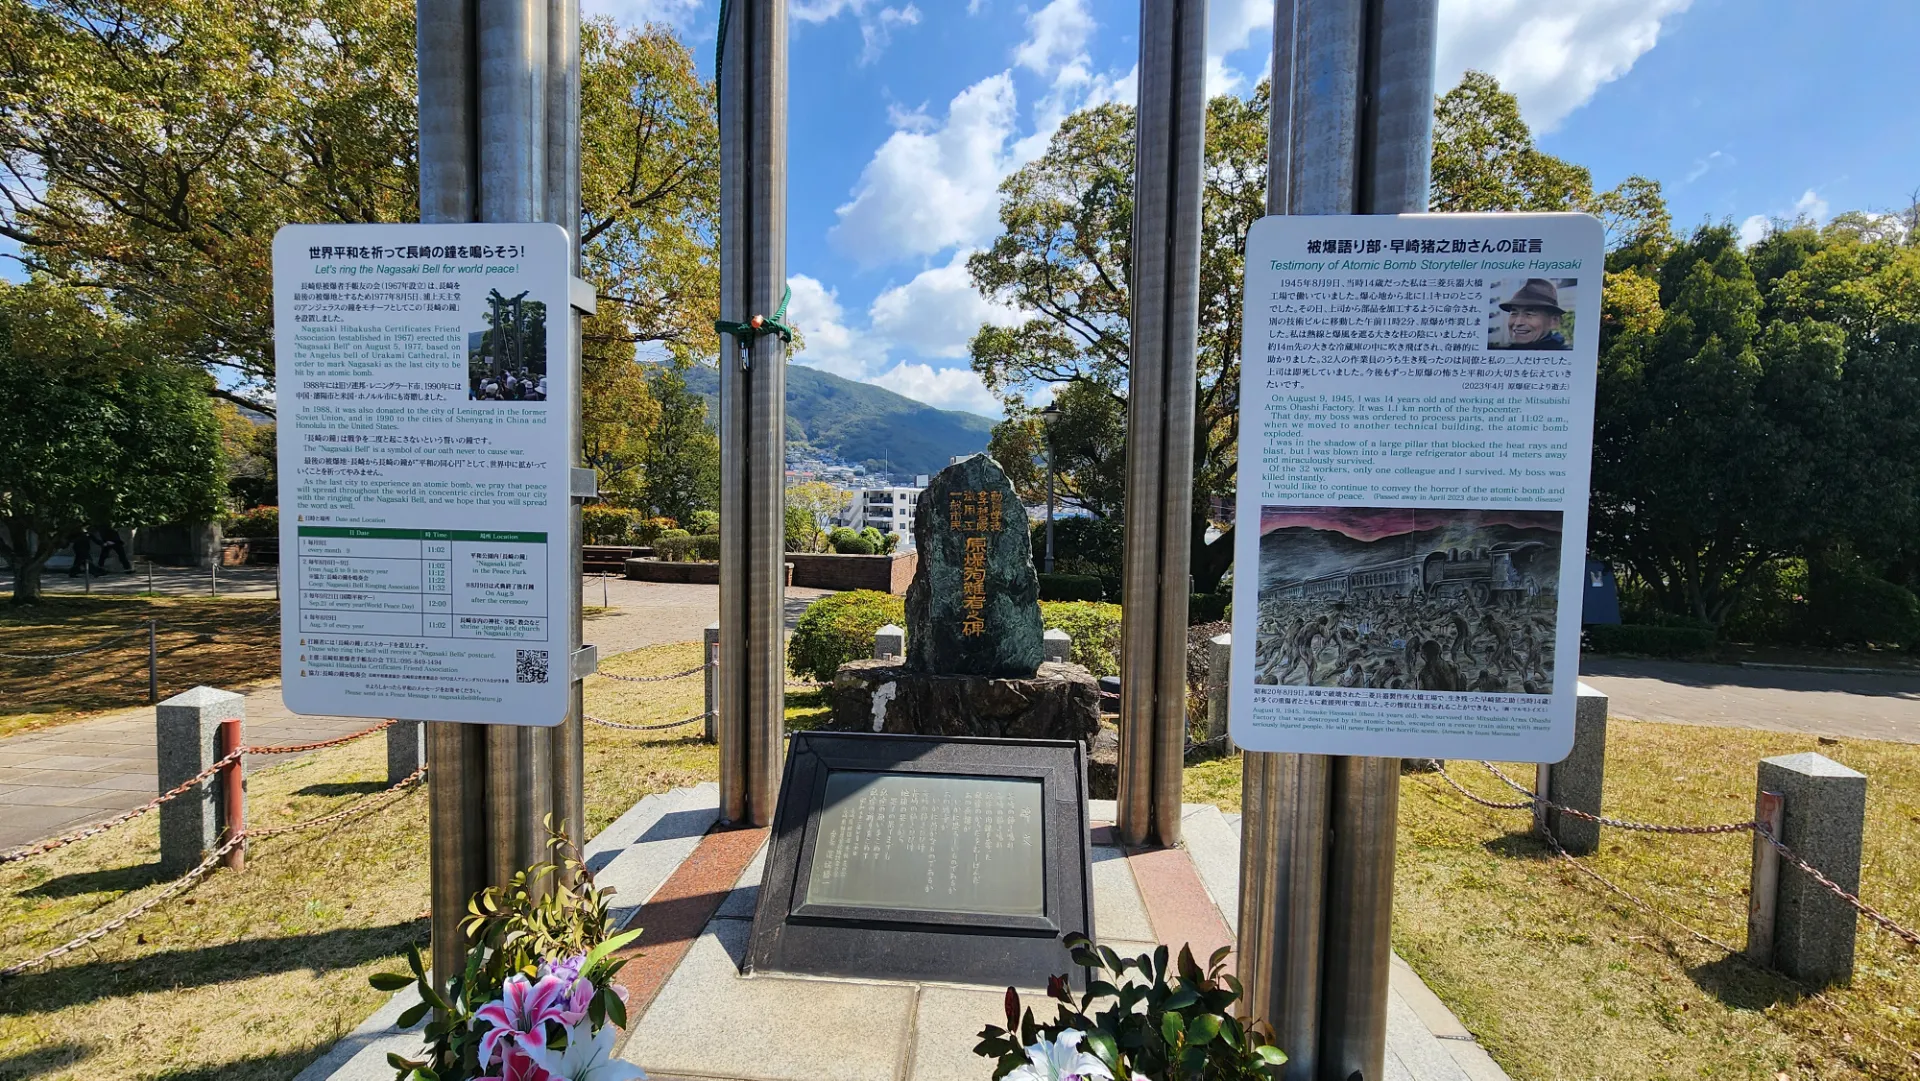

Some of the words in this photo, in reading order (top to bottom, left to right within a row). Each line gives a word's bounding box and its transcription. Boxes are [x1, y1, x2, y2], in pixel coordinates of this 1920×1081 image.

[1270, 260, 1324, 270] Testimony
[1341, 260, 1380, 269] Atomic
[1383, 259, 1416, 269] Bomb
[1420, 259, 1477, 269] Storyteller
[1480, 259, 1525, 269] Inosuke
[1528, 259, 1582, 269] Hayasaki
[314, 264, 336, 274] Let's
[339, 264, 356, 276] ring
[359, 264, 373, 273] the
[376, 264, 419, 275] Nagasaki
[422, 263, 440, 273] Bell
[442, 263, 455, 273] for
[457, 263, 483, 273] world
[485, 264, 519, 273] peace!
[301, 325, 336, 333] Nagasaki
[1286, 394, 1316, 403] August
[1459, 396, 1494, 404] working
[1525, 396, 1570, 404] Mitsubishi
[1289, 402, 1319, 410] Ohashi
[1307, 420, 1336, 428] moved
[387, 446, 412, 454] symbol
[1277, 491, 1324, 500] importance
